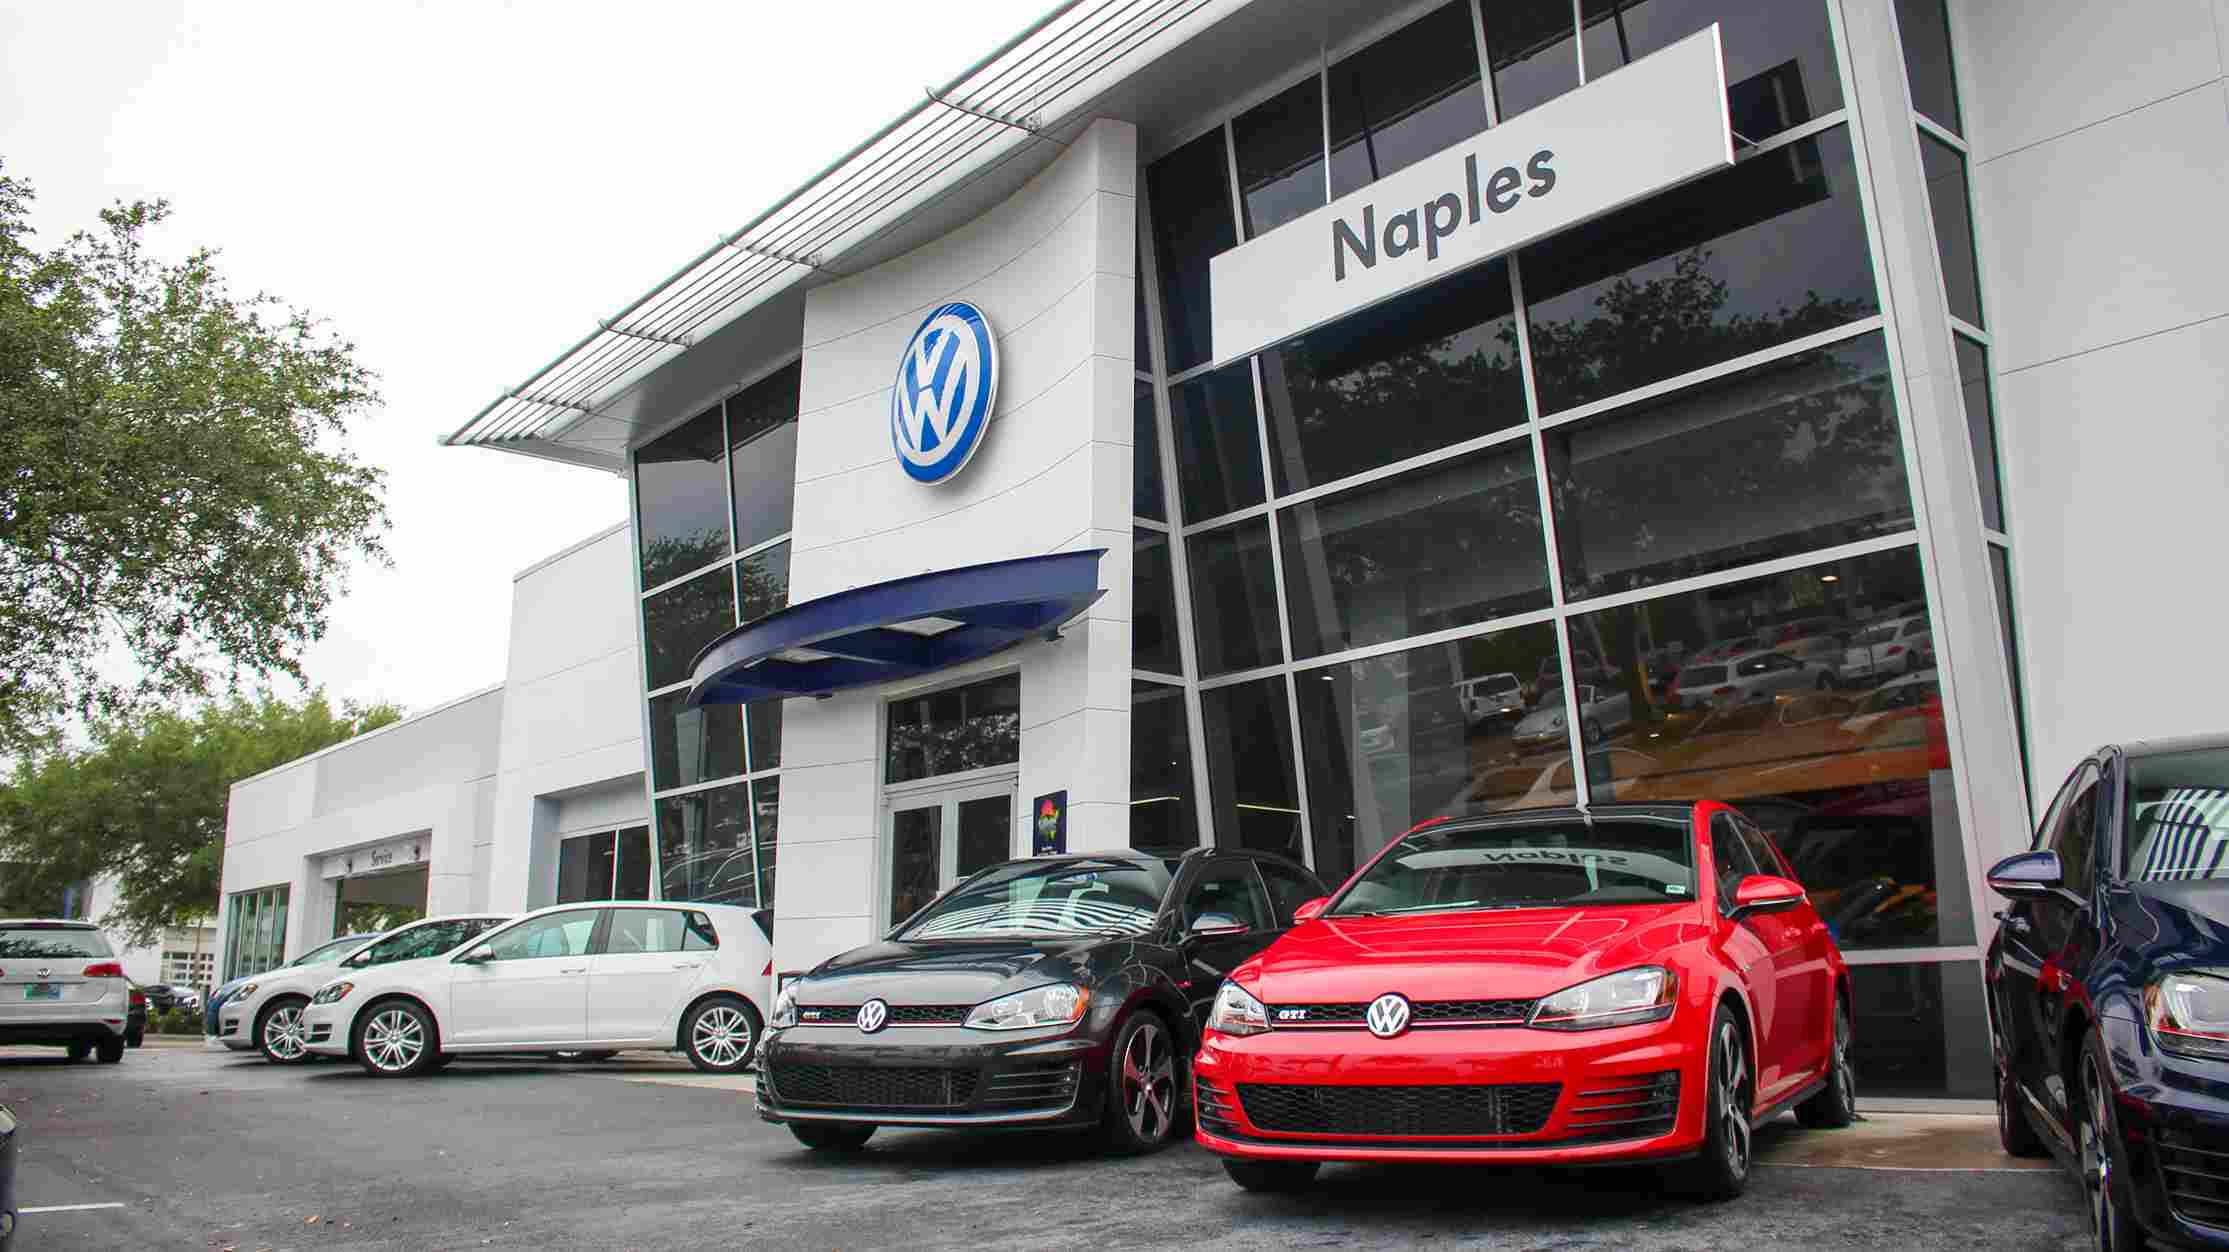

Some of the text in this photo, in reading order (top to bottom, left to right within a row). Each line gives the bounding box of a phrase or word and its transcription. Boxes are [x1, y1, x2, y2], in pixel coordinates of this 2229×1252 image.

[1332, 149, 1557, 283] Naples
[896, 310, 987, 470] VW
[858, 1000, 886, 1031] VW
[1279, 994, 1408, 1036] GTI VW
